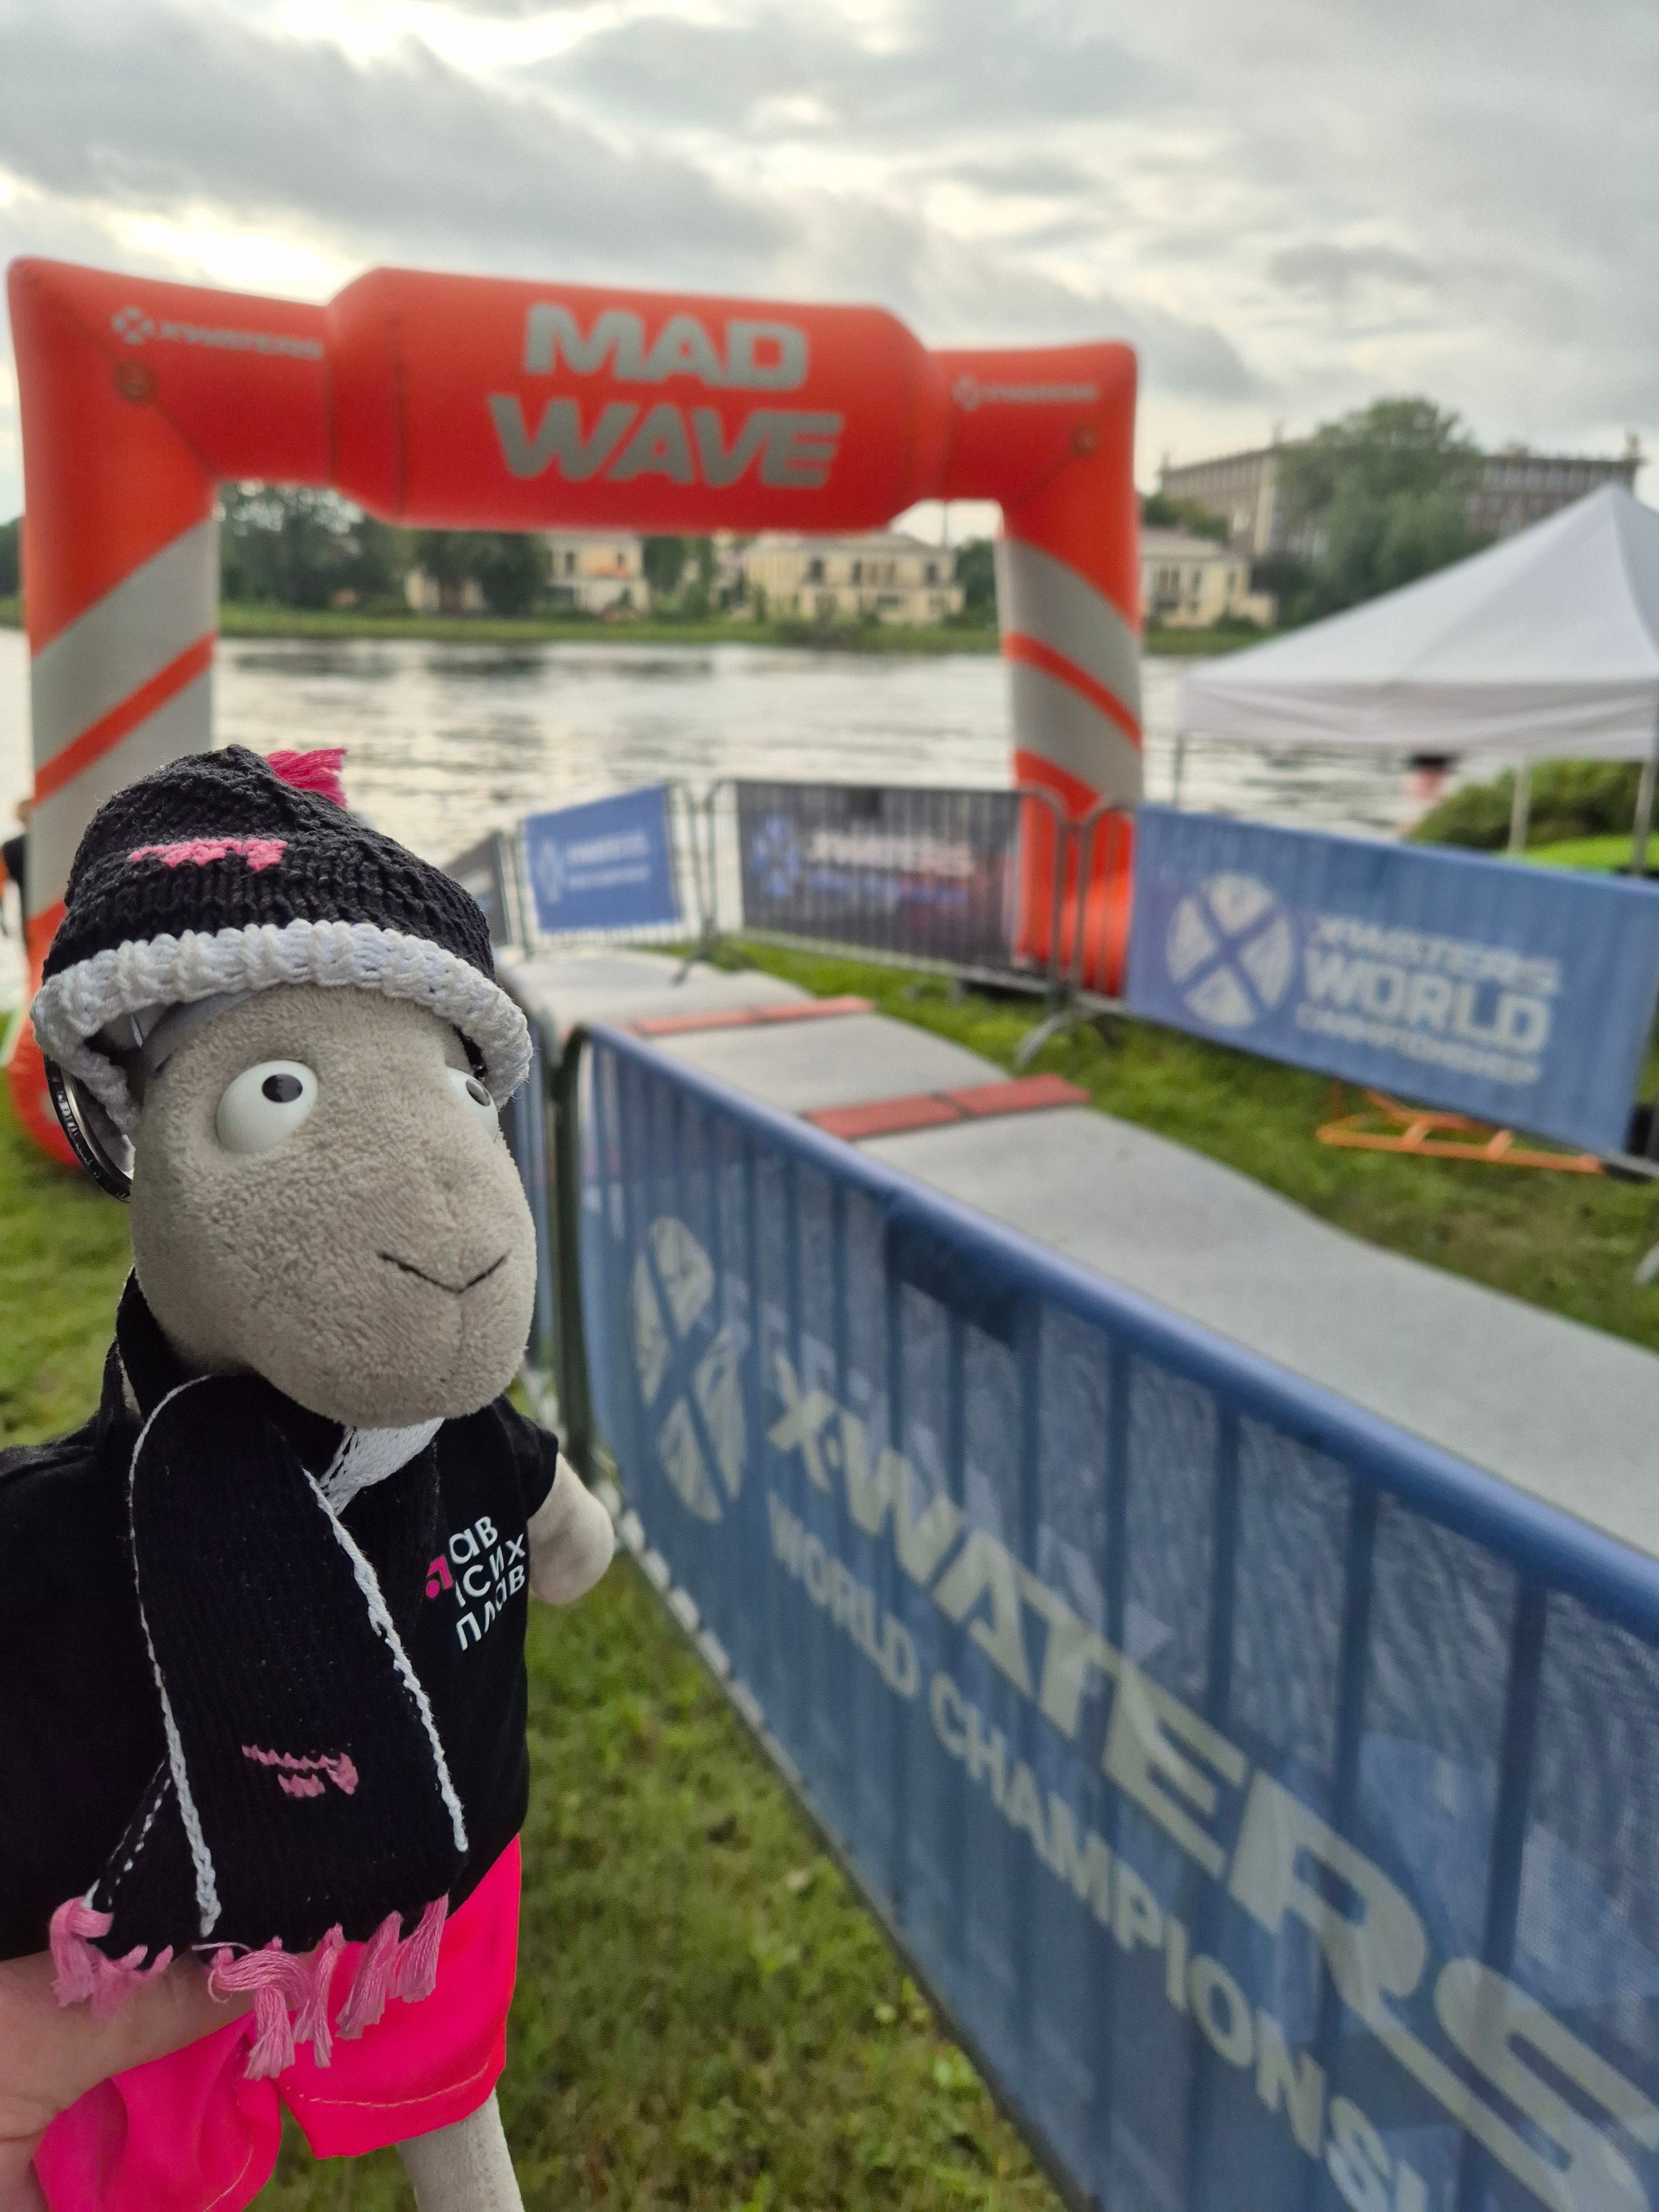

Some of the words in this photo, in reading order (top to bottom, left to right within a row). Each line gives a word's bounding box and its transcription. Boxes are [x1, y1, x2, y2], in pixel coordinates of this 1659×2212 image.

[524, 302, 807, 390] MAD
[487, 394, 842, 487] WAVE
[1304, 946, 1551, 1055] WORLD
[768, 1492, 920, 1698] WORLD
